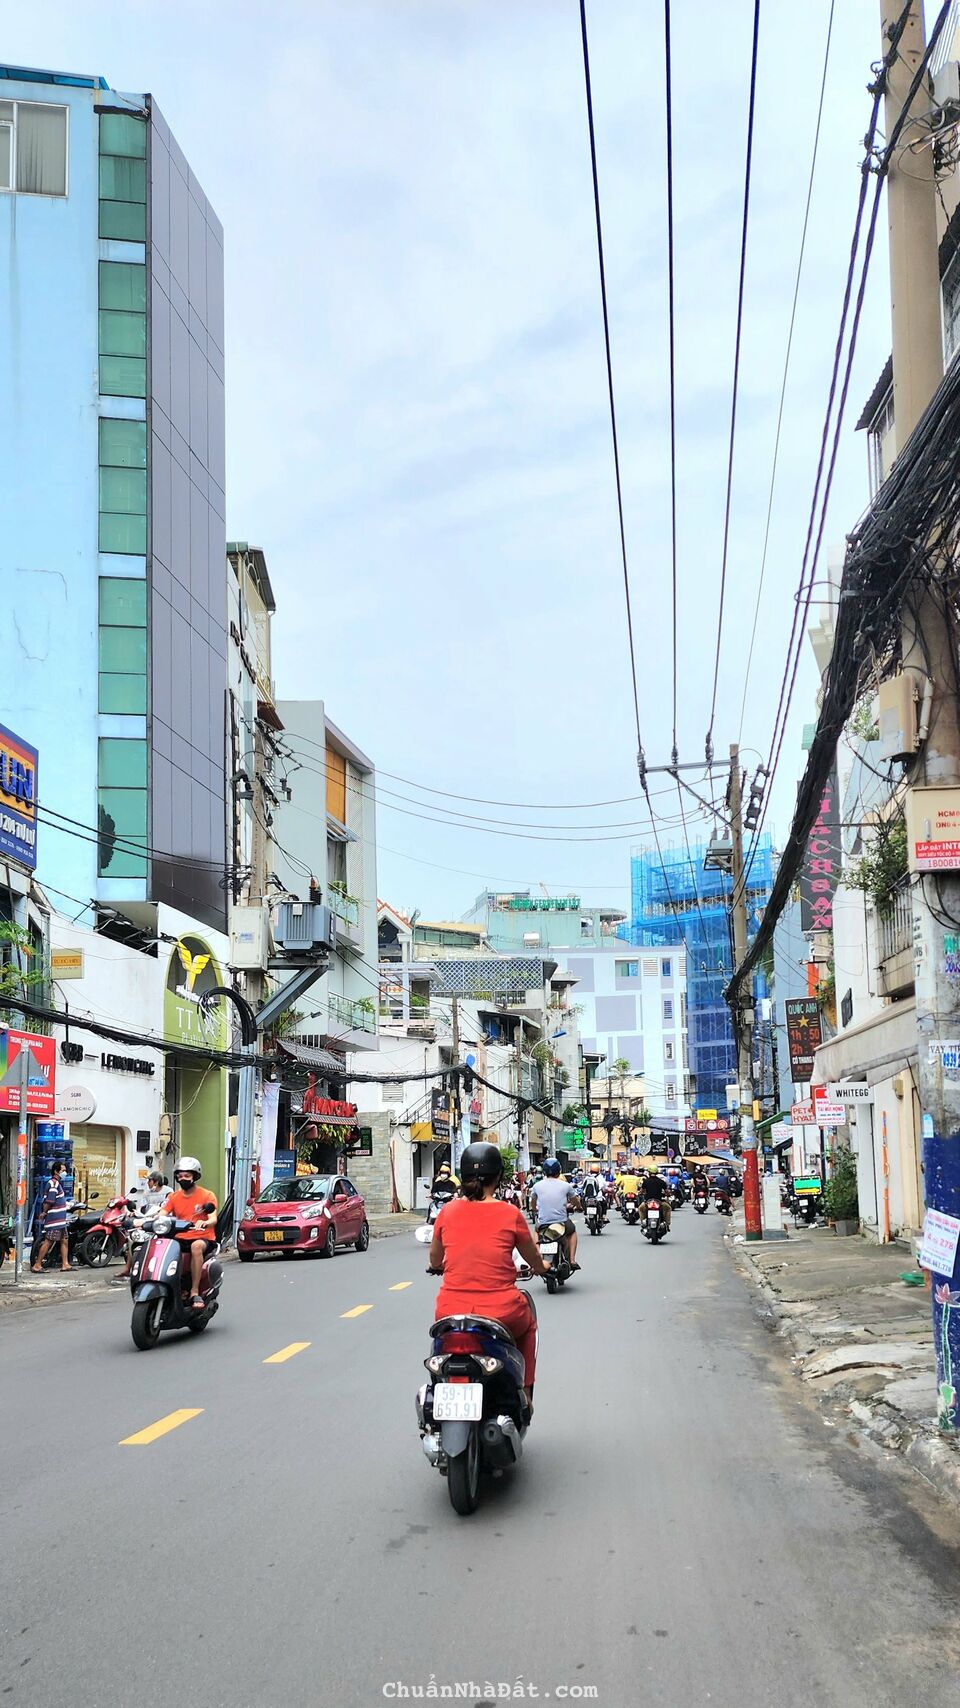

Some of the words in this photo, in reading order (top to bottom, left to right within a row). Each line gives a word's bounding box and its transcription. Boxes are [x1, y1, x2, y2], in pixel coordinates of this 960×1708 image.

[788, 1001, 804, 1015] QUỐC
[805, 1003, 818, 1013] ANH
[836, 1088, 869, 1098] WHITEGG
[442, 1385, 474, 1401] 59-T1
[437, 1402, 477, 1418] 651.91
